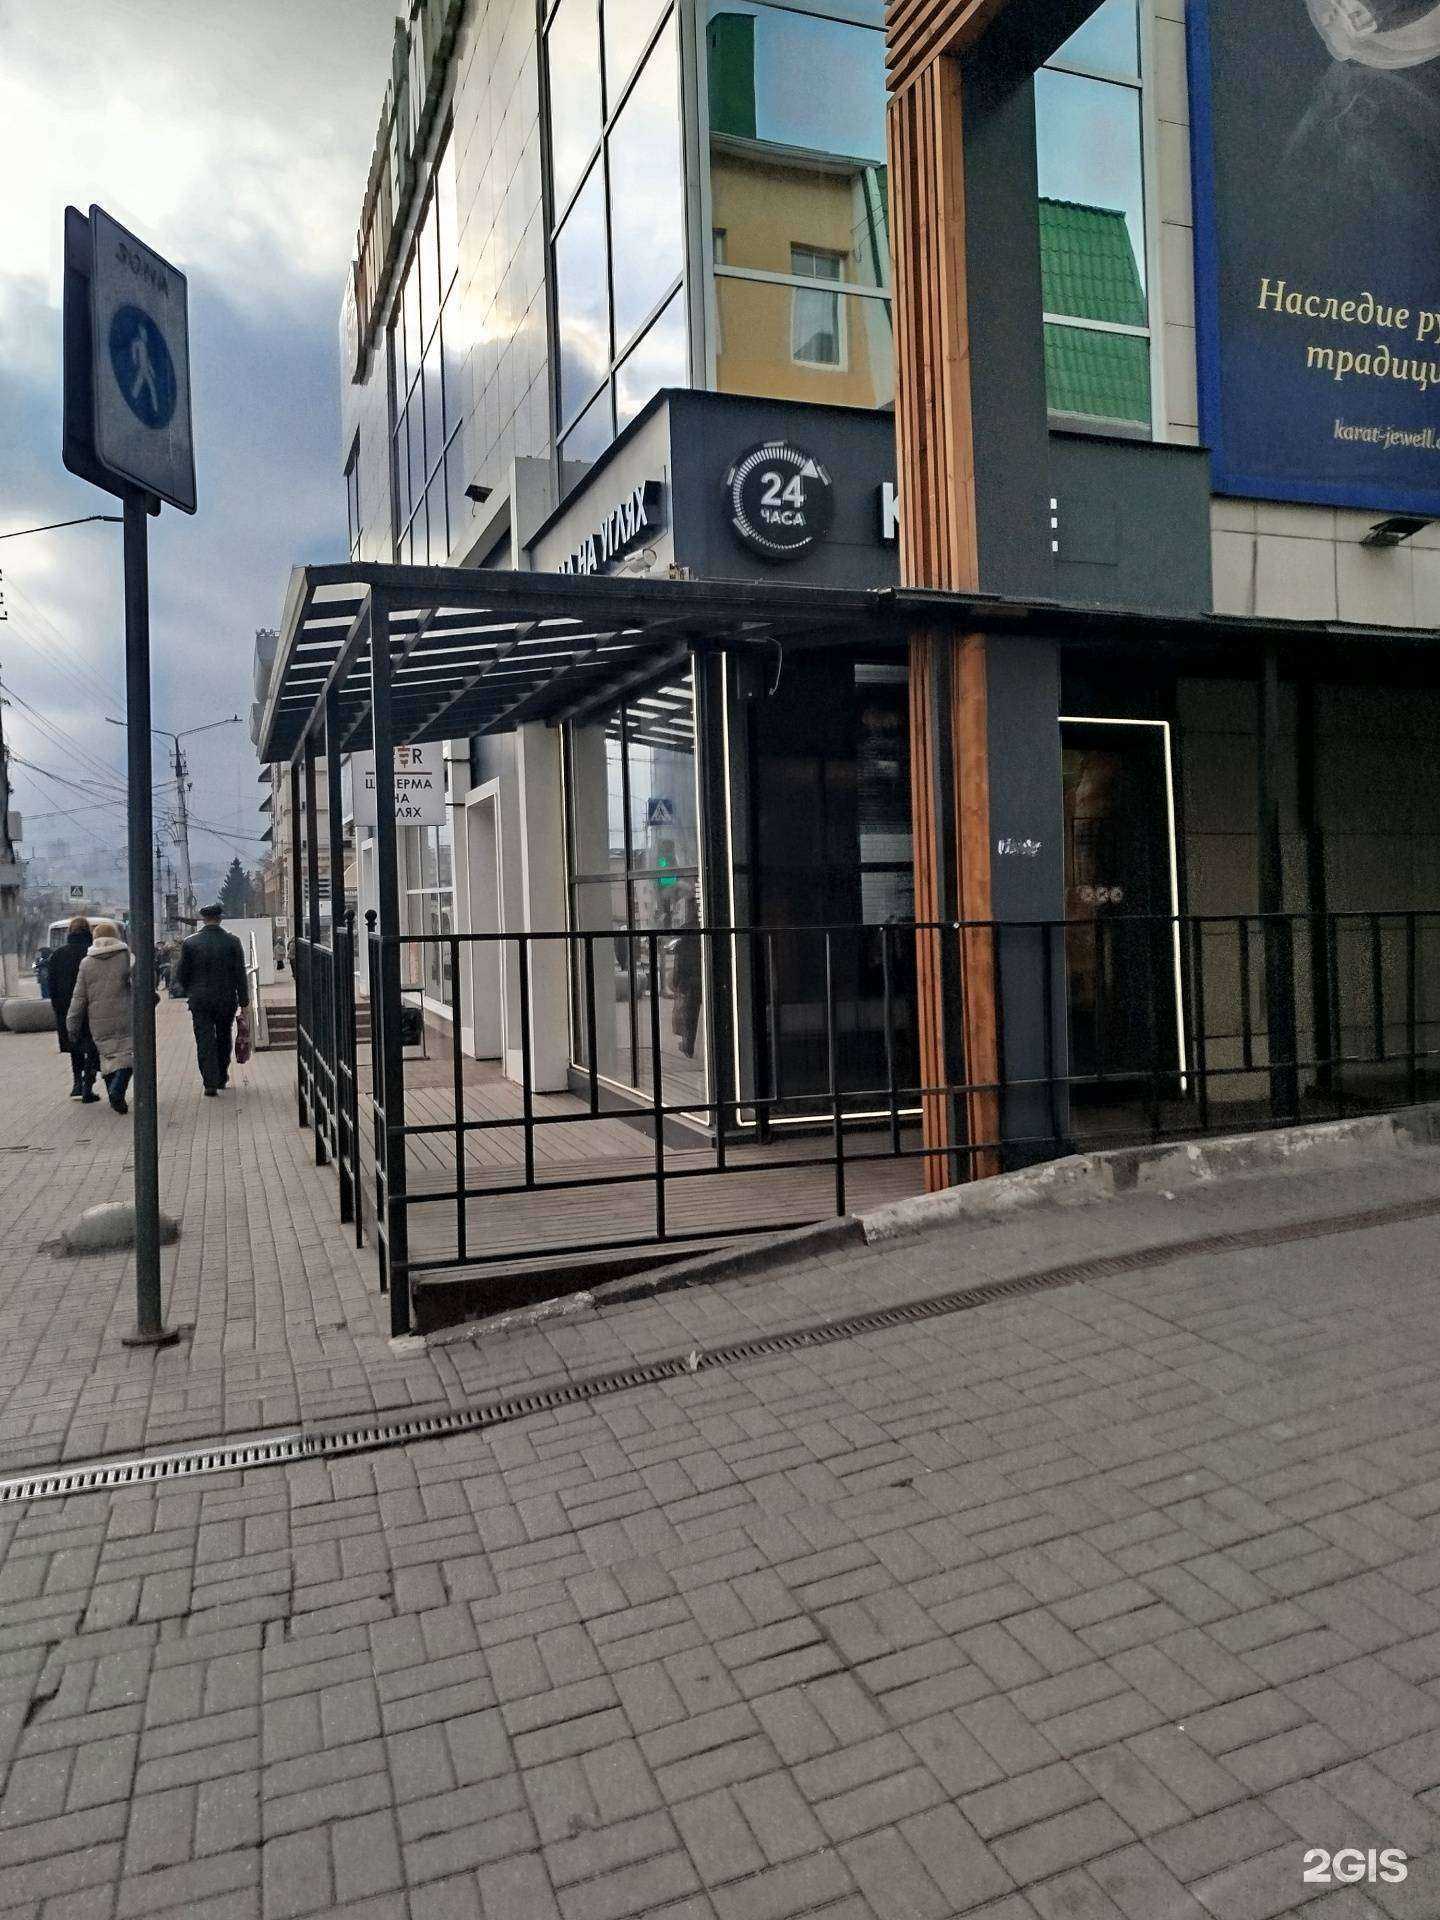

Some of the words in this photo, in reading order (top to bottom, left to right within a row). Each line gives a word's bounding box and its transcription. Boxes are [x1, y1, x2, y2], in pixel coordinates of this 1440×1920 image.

[1257, 278, 1410, 330] Наследие
[760, 471, 805, 508] 24
[579, 533, 598, 575] НА
[600, 480, 648, 562] УГЛЯХ
[760, 509, 806, 526] ЧАСА
[395, 807, 422, 818] ЛЯХ
